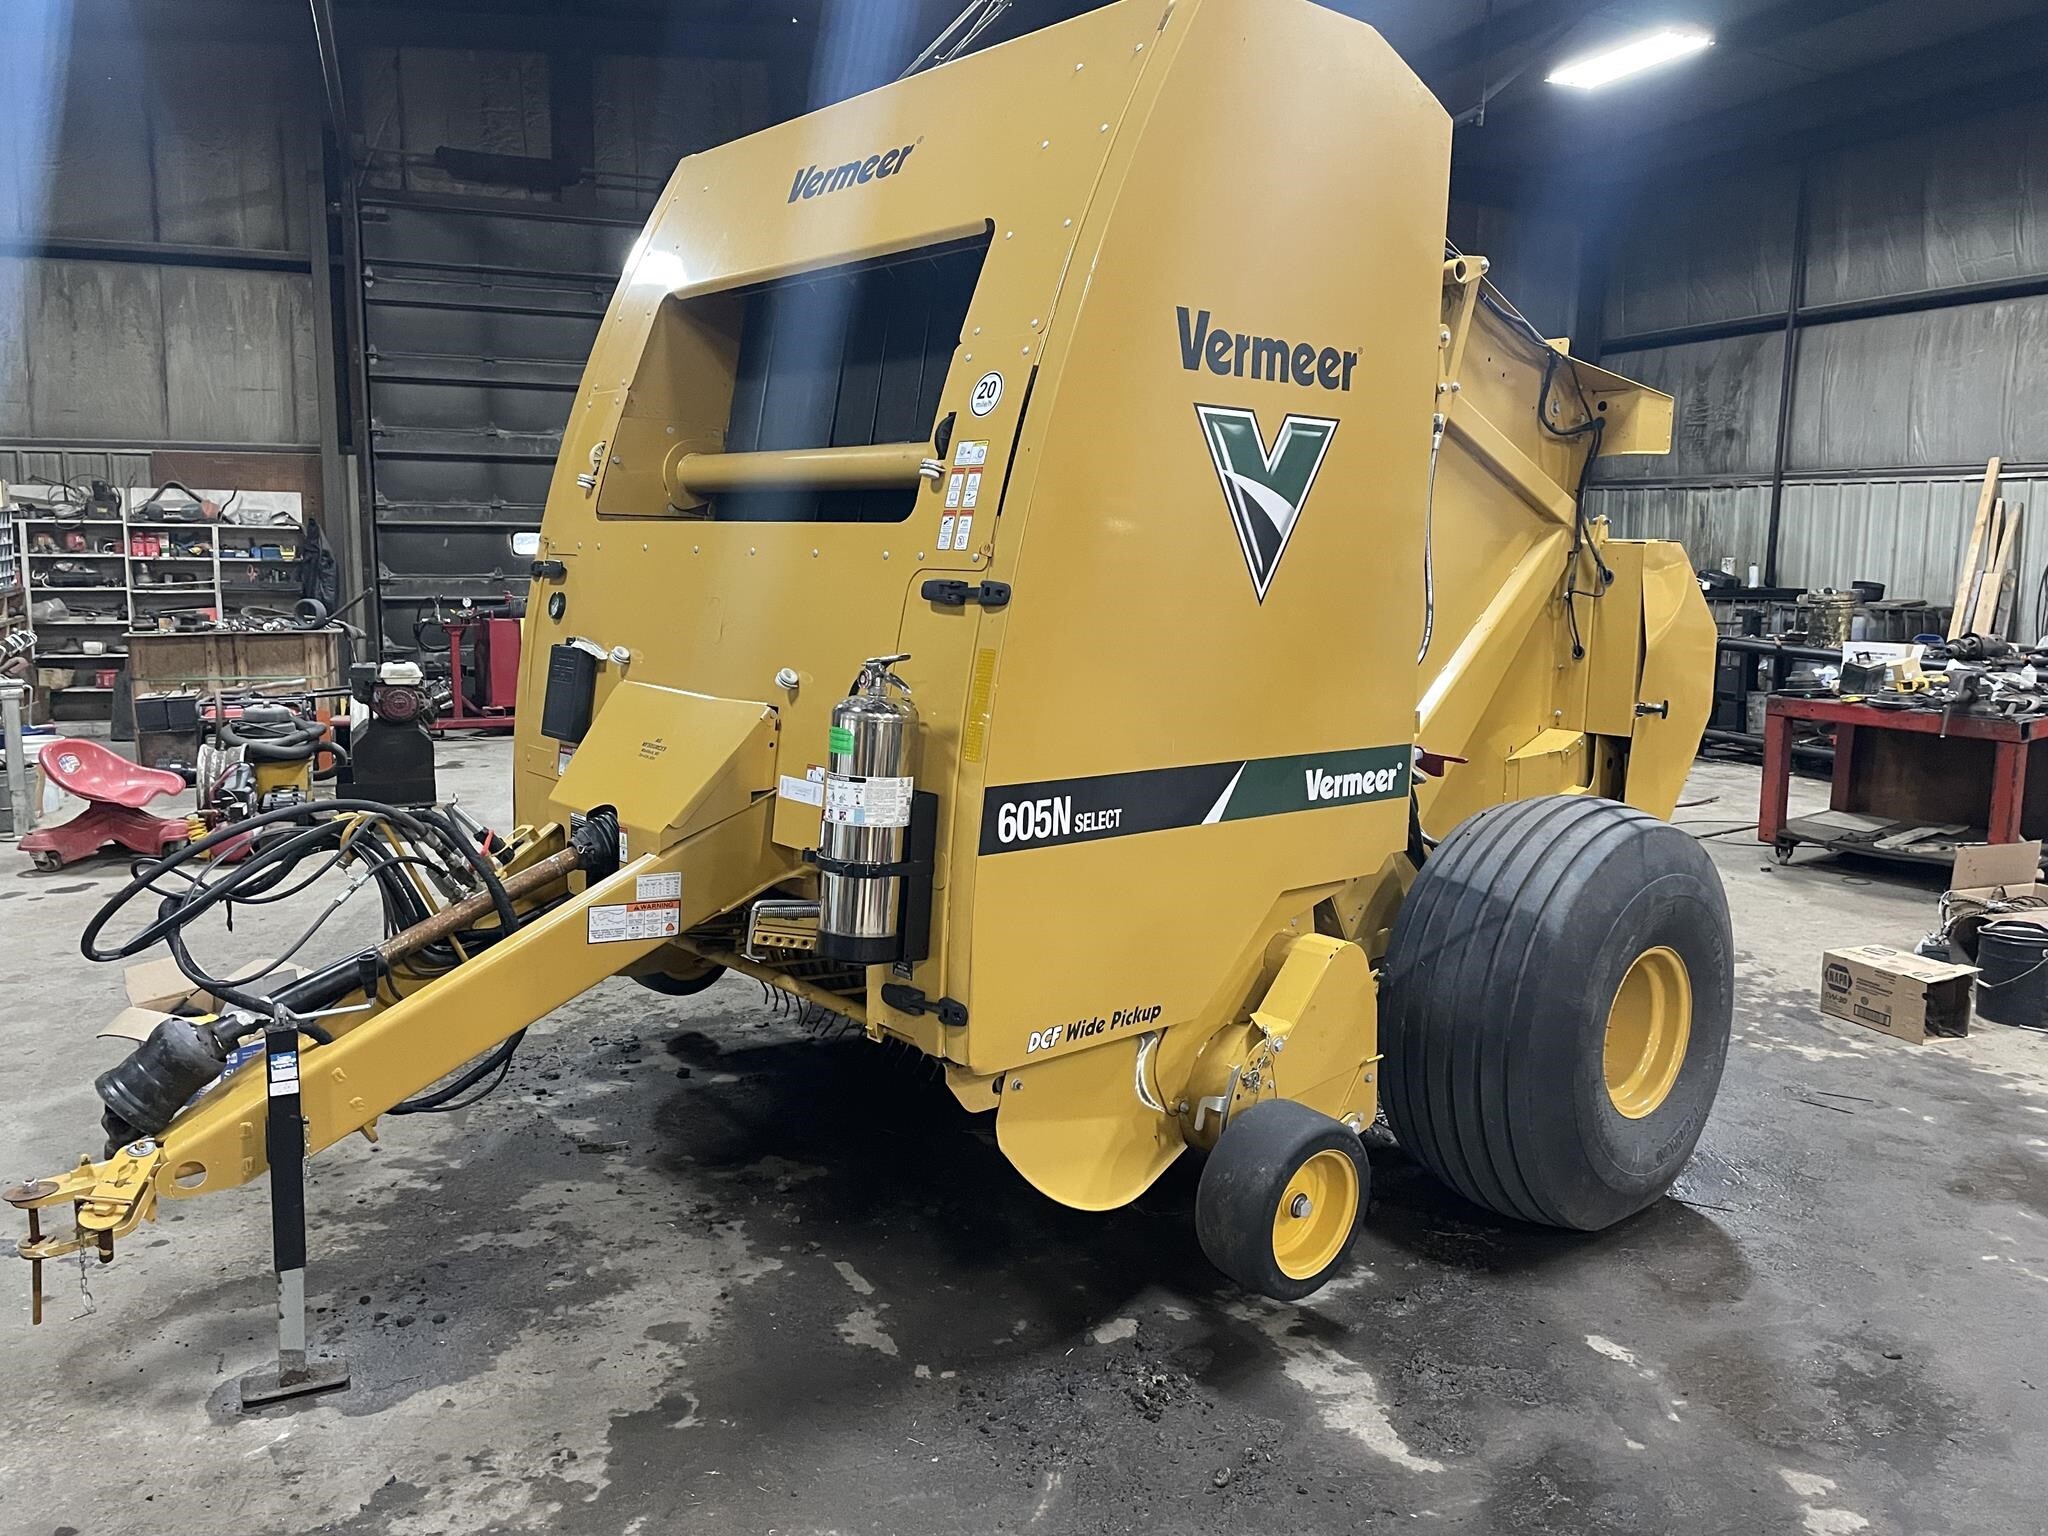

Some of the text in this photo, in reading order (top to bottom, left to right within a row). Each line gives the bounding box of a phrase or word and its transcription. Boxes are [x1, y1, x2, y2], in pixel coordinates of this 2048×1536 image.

[787, 143, 915, 204] Vermeer
[1176, 305, 1358, 391] Vermeer
[976, 380, 997, 400] 20
[1305, 768, 1397, 801] Vermeer
[998, 795, 1122, 843] 605N SELECT
[640, 901, 674, 910] WARNING
[1827, 968, 1849, 989] NAPA
[1026, 1005, 1162, 1054] DCF Wide Pickup
